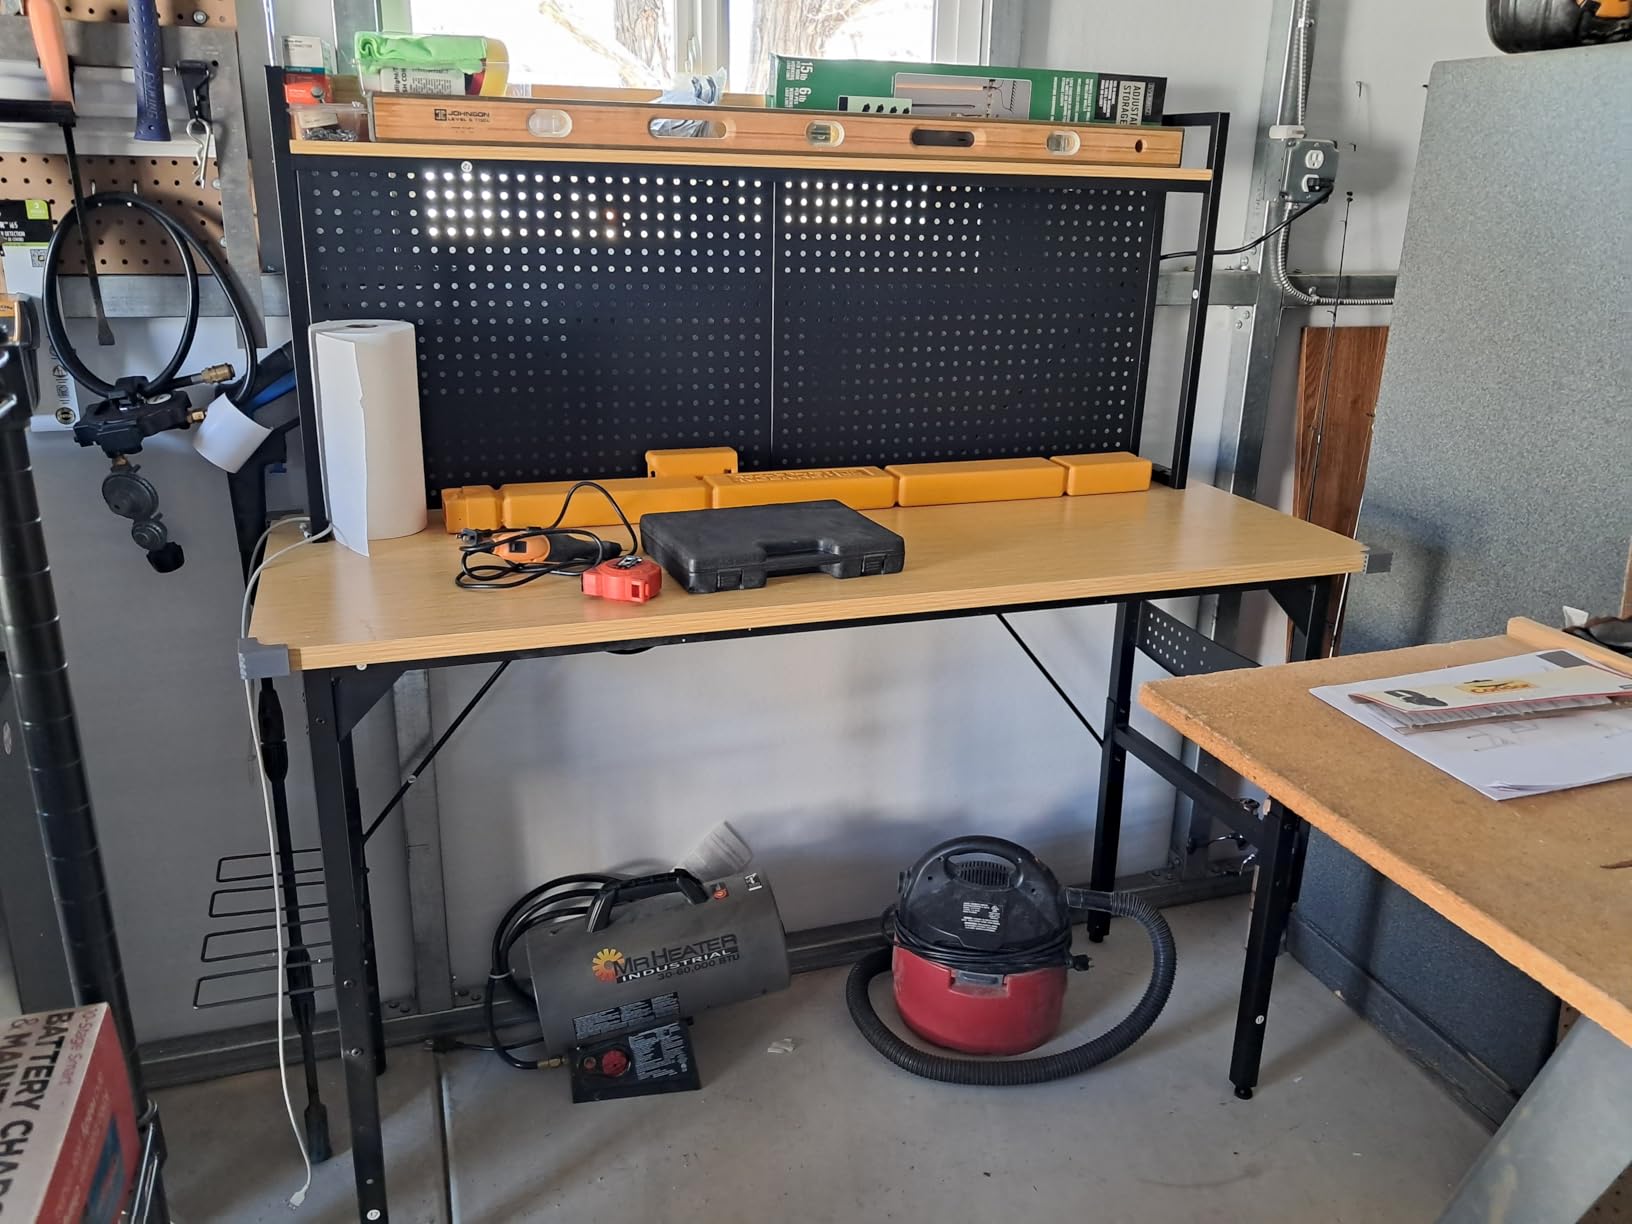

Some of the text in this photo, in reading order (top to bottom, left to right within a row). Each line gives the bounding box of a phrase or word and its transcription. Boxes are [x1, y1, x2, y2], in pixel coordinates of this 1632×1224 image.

[800, 62, 814, 81] 15 lb
[798, 87, 812, 103] 6 lb
[1119, 85, 1131, 125] STORAGE
[622, 950, 732, 982] INDUSTRIAL
[651, 934, 738, 966] HEATER
[719, 953, 740, 965] BTU
[11, 1018, 39, 1030] &
[60, 1054, 82, 1086] Smart
[0, 1012, 74, 1213] BATTERY CHAR
